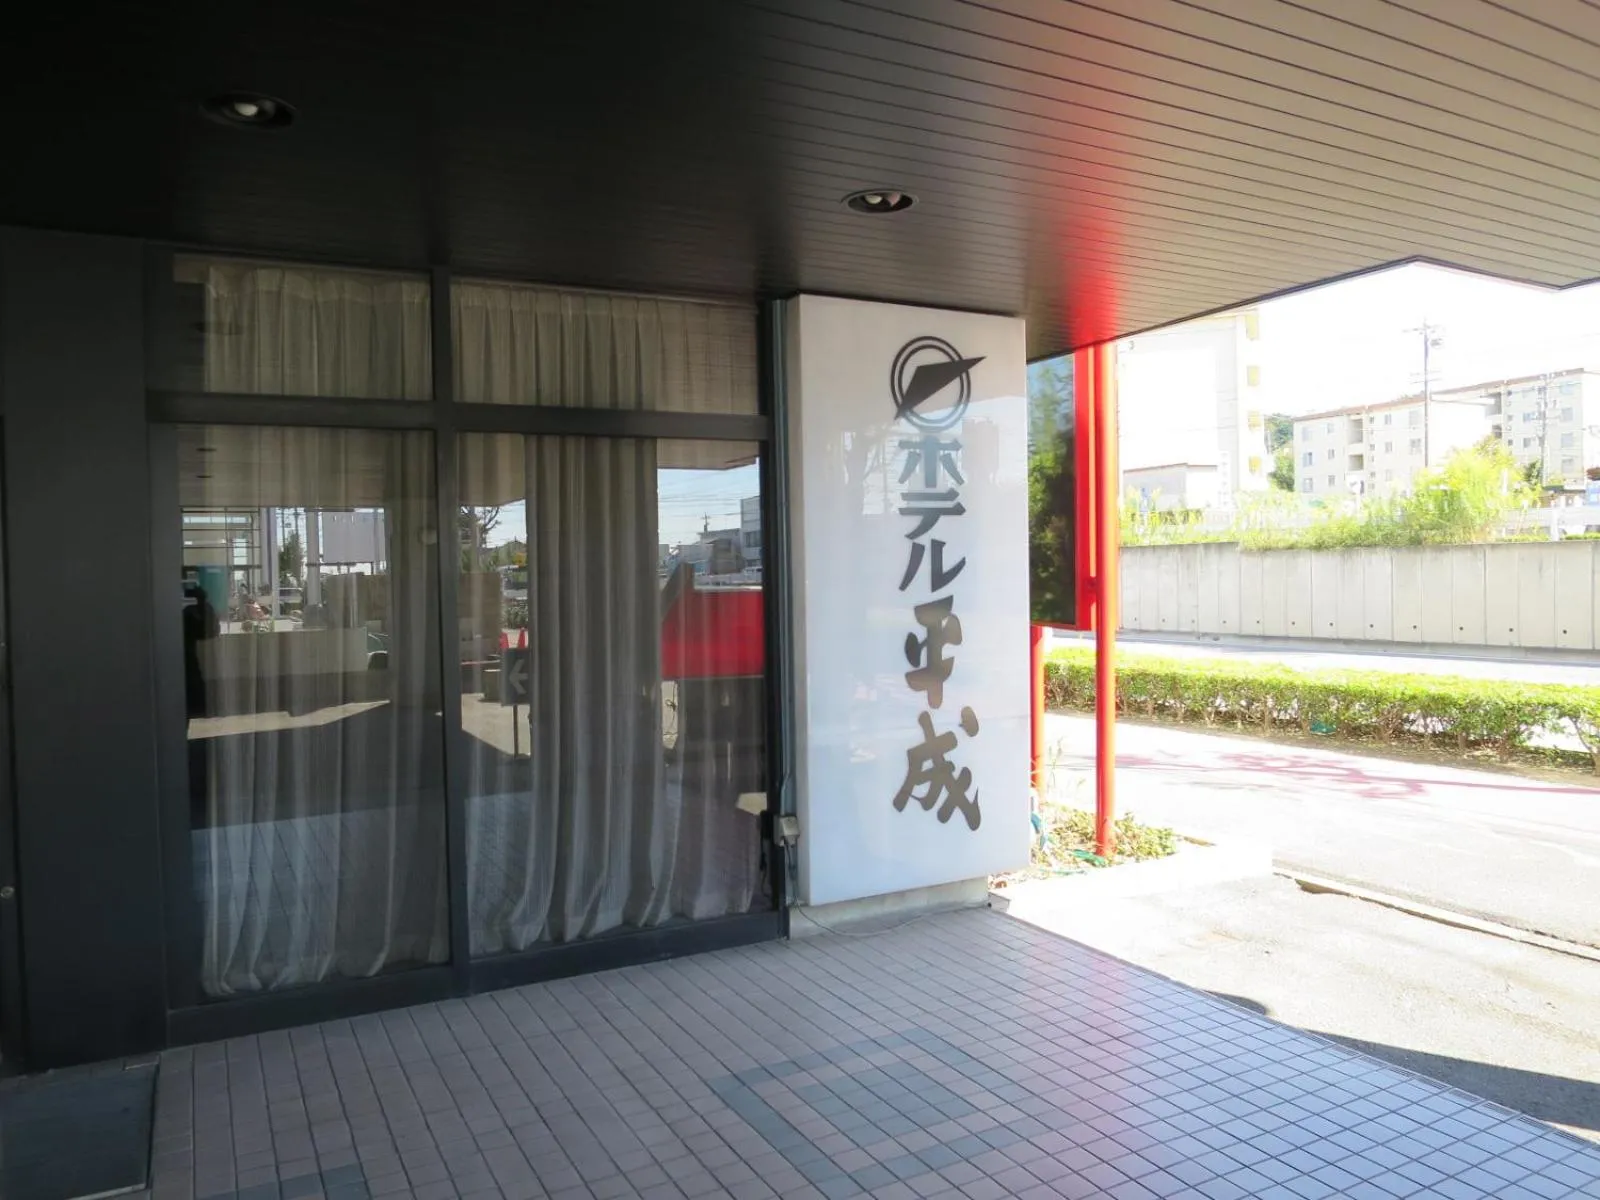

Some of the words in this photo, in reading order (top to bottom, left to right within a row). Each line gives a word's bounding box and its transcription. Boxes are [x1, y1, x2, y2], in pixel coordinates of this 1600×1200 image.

[893, 435, 981, 831] ホテル平成
